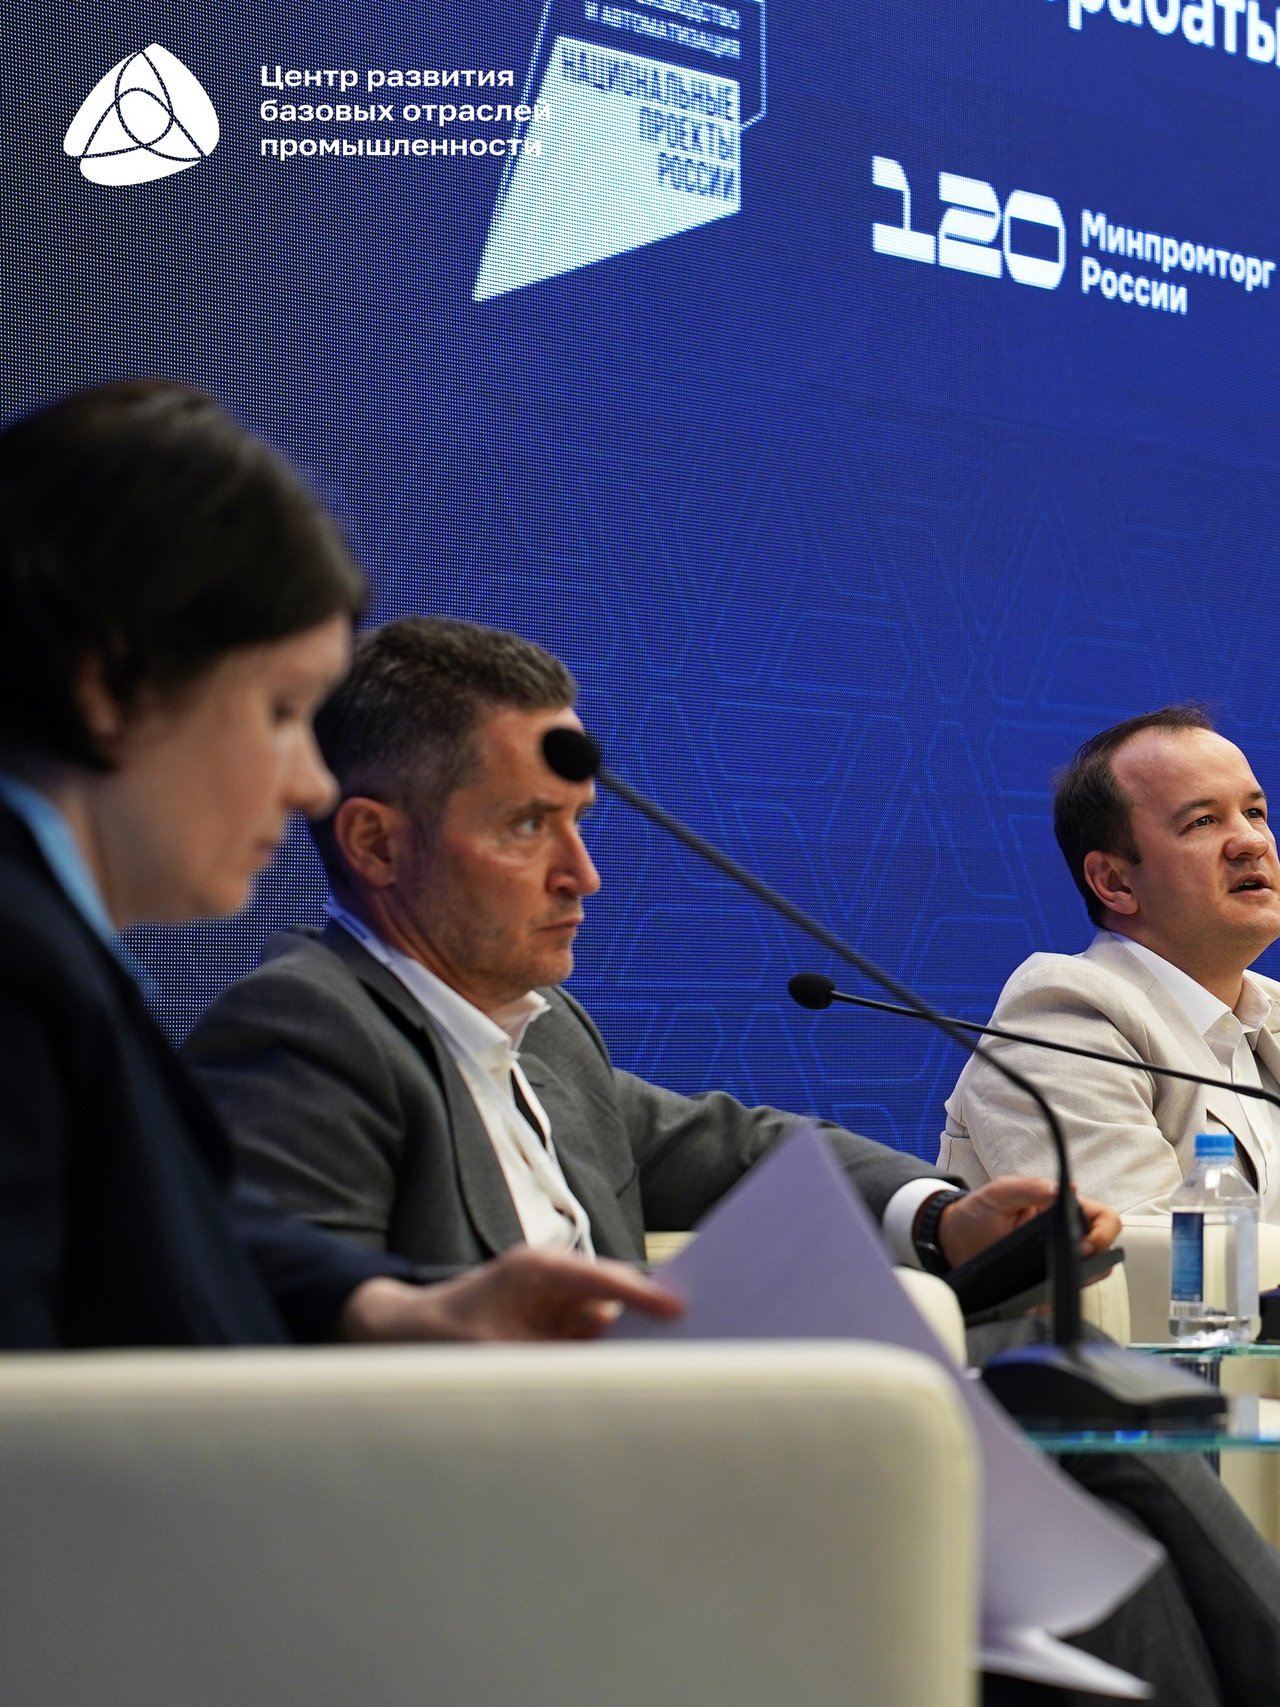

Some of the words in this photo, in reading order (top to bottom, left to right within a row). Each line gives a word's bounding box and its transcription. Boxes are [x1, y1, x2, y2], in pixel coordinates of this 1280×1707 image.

[562, 46, 734, 122] НАЦИОНАЛЬНЫЕ
[640, 106, 735, 162] ПРОЕКТЫ
[658, 152, 735, 201] РОССИИ
[872, 155, 1066, 291] 120
[1081, 207, 1277, 293] Минпромторг
[1081, 256, 1188, 316] России
